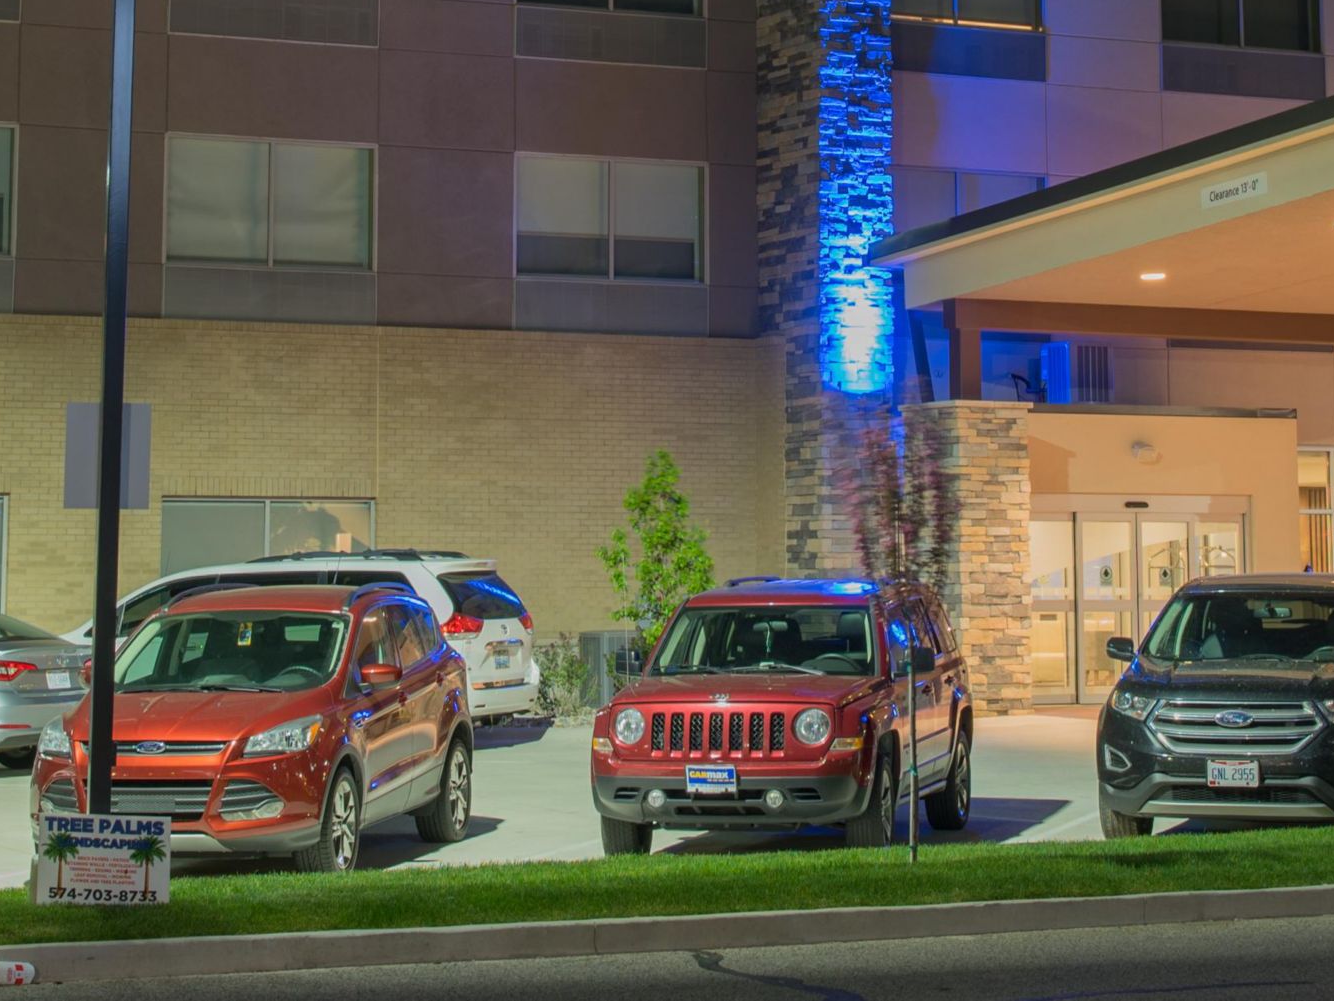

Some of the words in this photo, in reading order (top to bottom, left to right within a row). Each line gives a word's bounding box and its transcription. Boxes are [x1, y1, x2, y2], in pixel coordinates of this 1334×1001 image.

[1209, 185, 1240, 202] Clearance
[1211, 767, 1228, 780] GNL
[1231, 767, 1255, 781] 2955
[45, 816, 94, 833] TREE
[98, 818, 165, 836] PALMS
[48, 887, 157, 902] 574-703-8733
